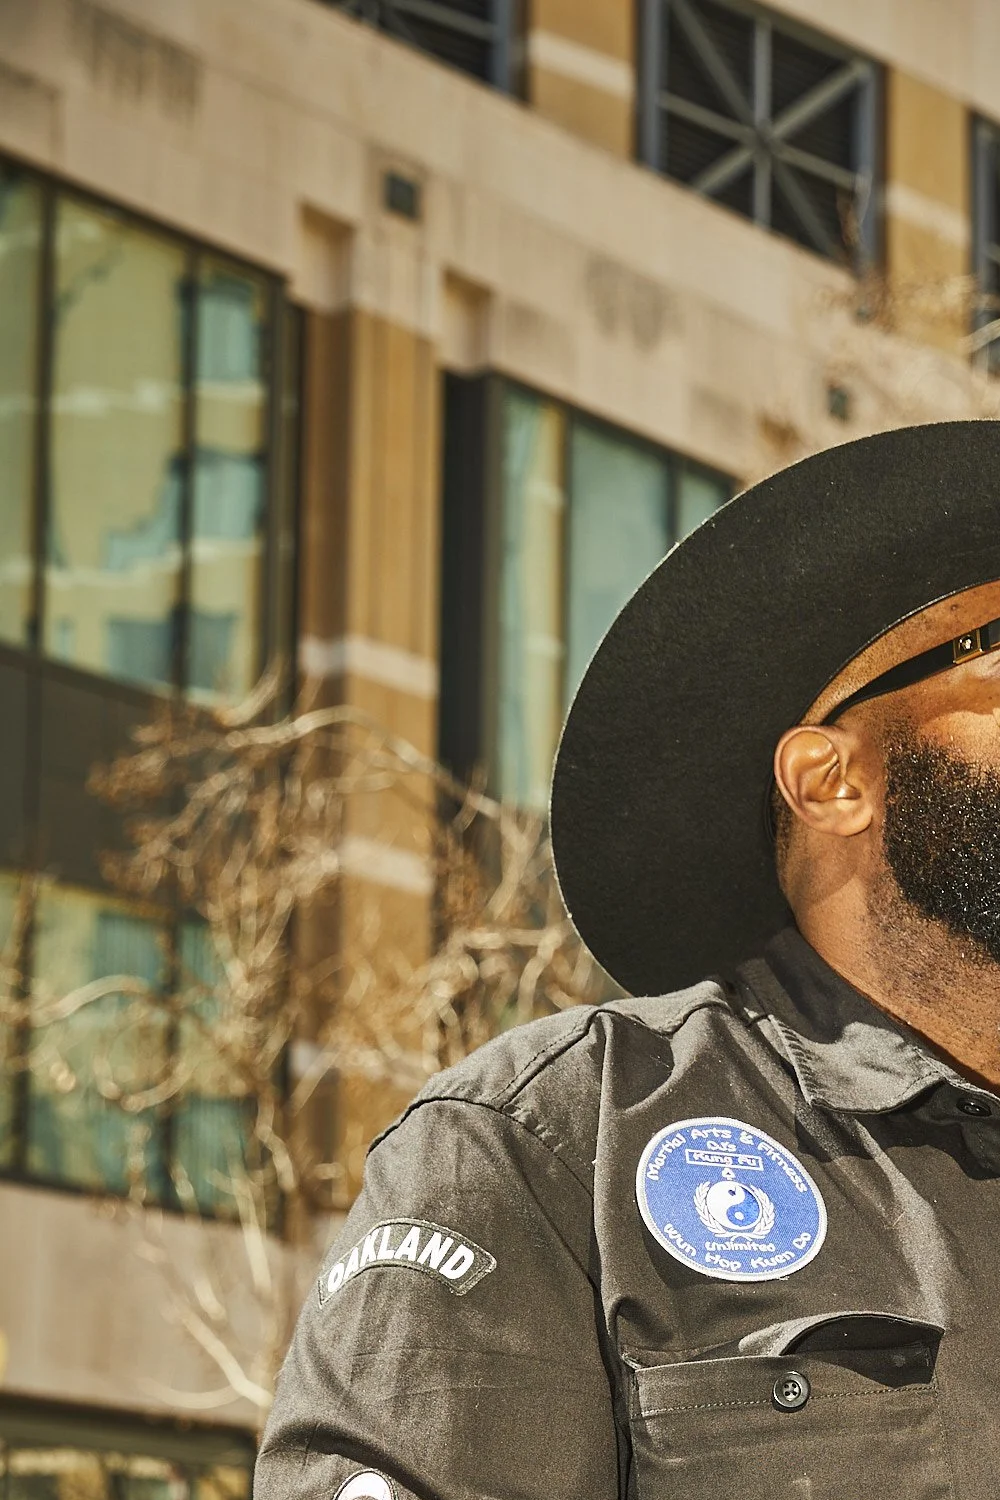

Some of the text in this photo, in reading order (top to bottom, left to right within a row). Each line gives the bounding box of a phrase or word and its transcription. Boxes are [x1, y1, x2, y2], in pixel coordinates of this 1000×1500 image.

[646, 1127, 808, 1193] Martial Arts & Fitness
[693, 1151, 757, 1166] Kung Fu
[327, 1225, 475, 1293] OAKLAND
[664, 1223, 697, 1256] Wun
[705, 1252, 742, 1271] Hop
[751, 1250, 795, 1268] Kuen
